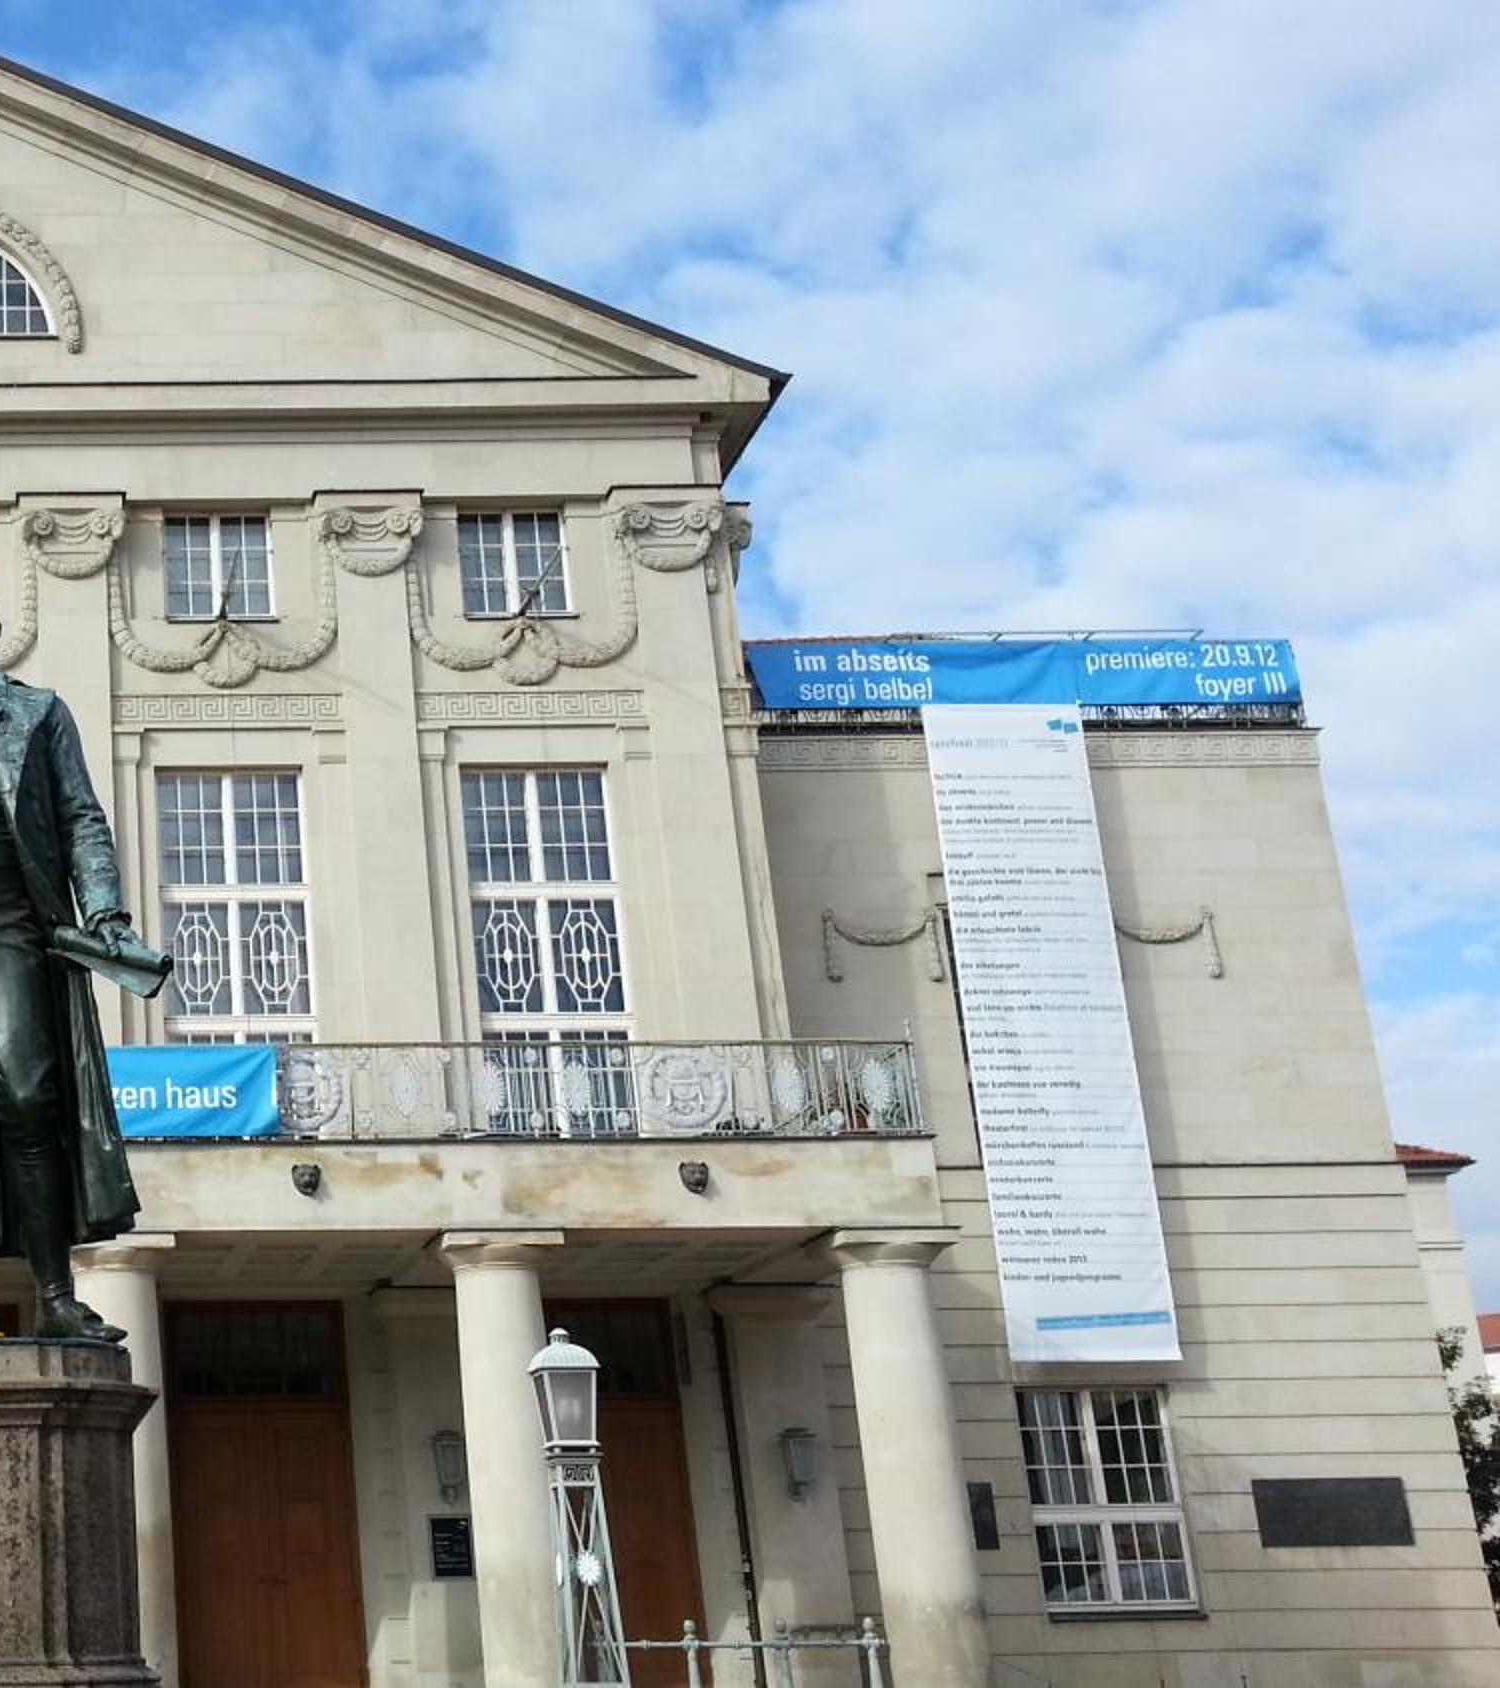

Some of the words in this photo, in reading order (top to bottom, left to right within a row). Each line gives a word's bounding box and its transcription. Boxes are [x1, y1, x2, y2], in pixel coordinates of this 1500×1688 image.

[793, 649, 826, 671] im
[836, 648, 931, 671] abseits
[1086, 646, 1195, 676] premiere:
[1201, 644, 1278, 668] 20.9.12
[800, 678, 855, 705] sergi
[863, 677, 933, 701] belbel
[1195, 673, 1255, 700] foyer
[111, 1086, 157, 1110] zen
[165, 1077, 237, 1110] haus
